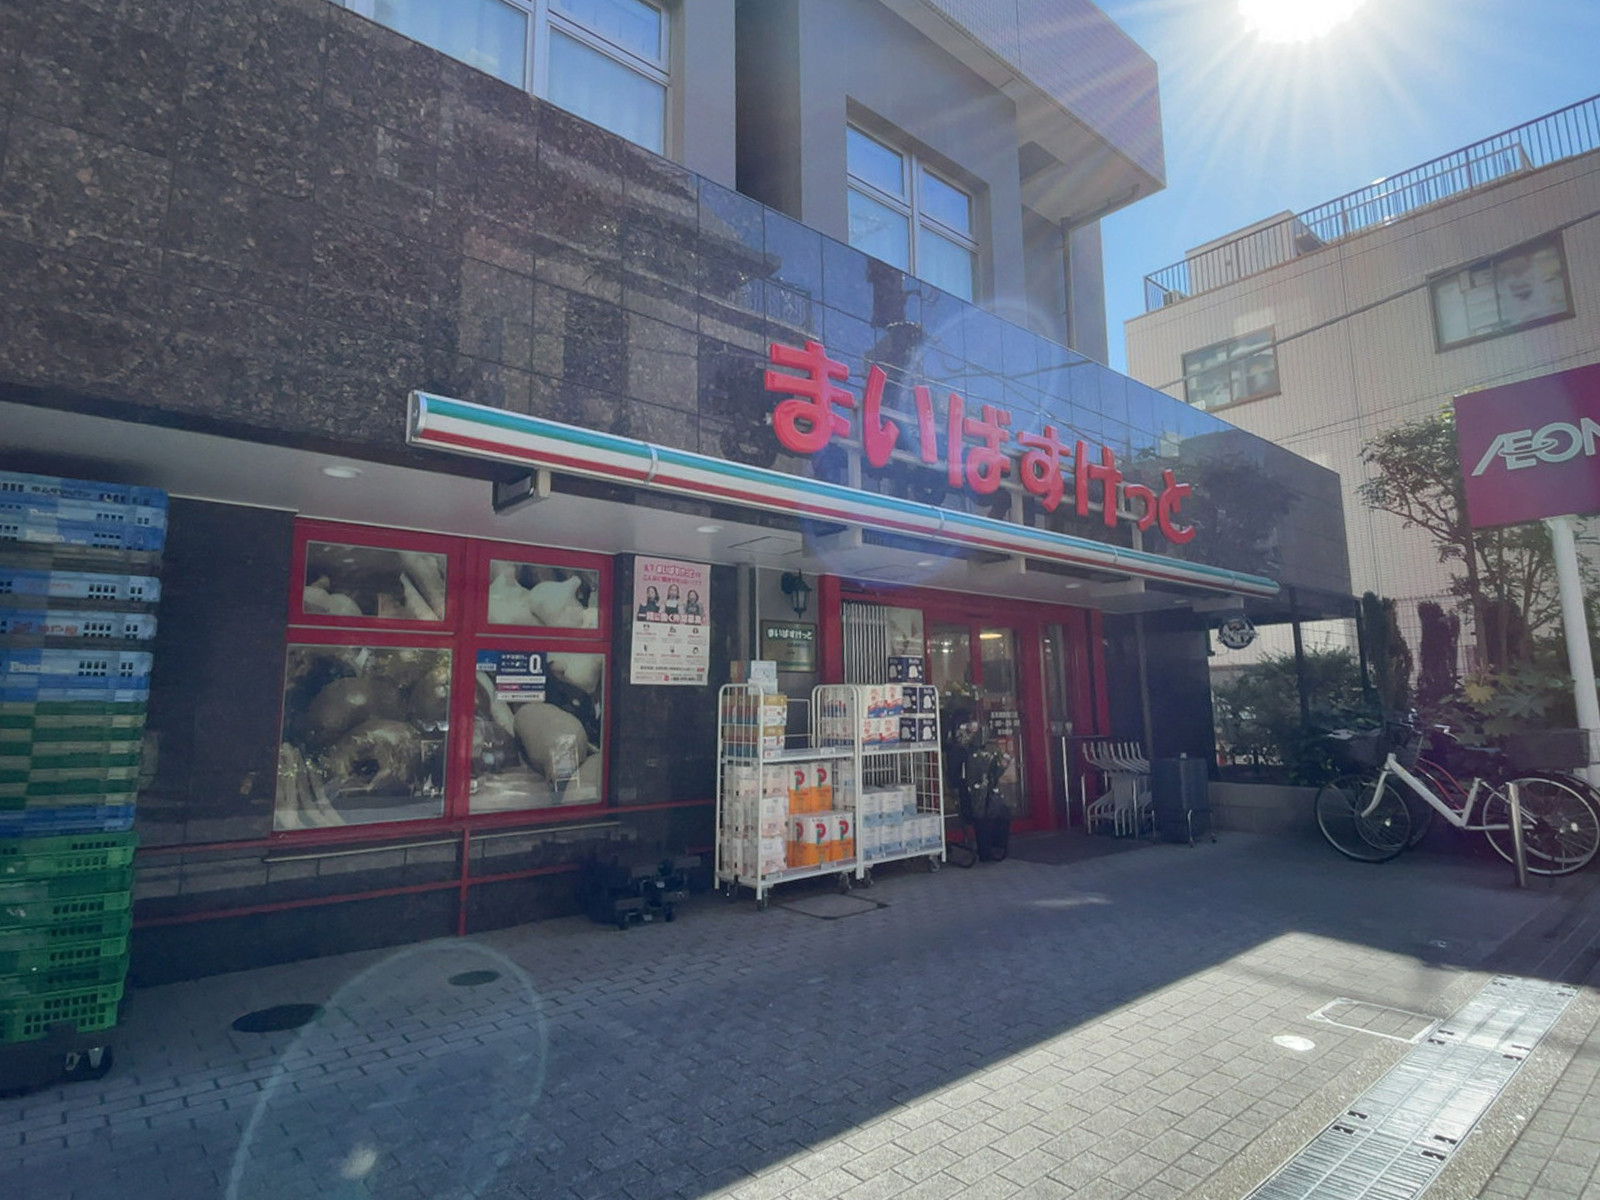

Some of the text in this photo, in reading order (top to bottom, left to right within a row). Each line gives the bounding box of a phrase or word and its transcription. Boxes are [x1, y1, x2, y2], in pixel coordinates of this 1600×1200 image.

[764, 340, 1197, 545] まいばすけっと
